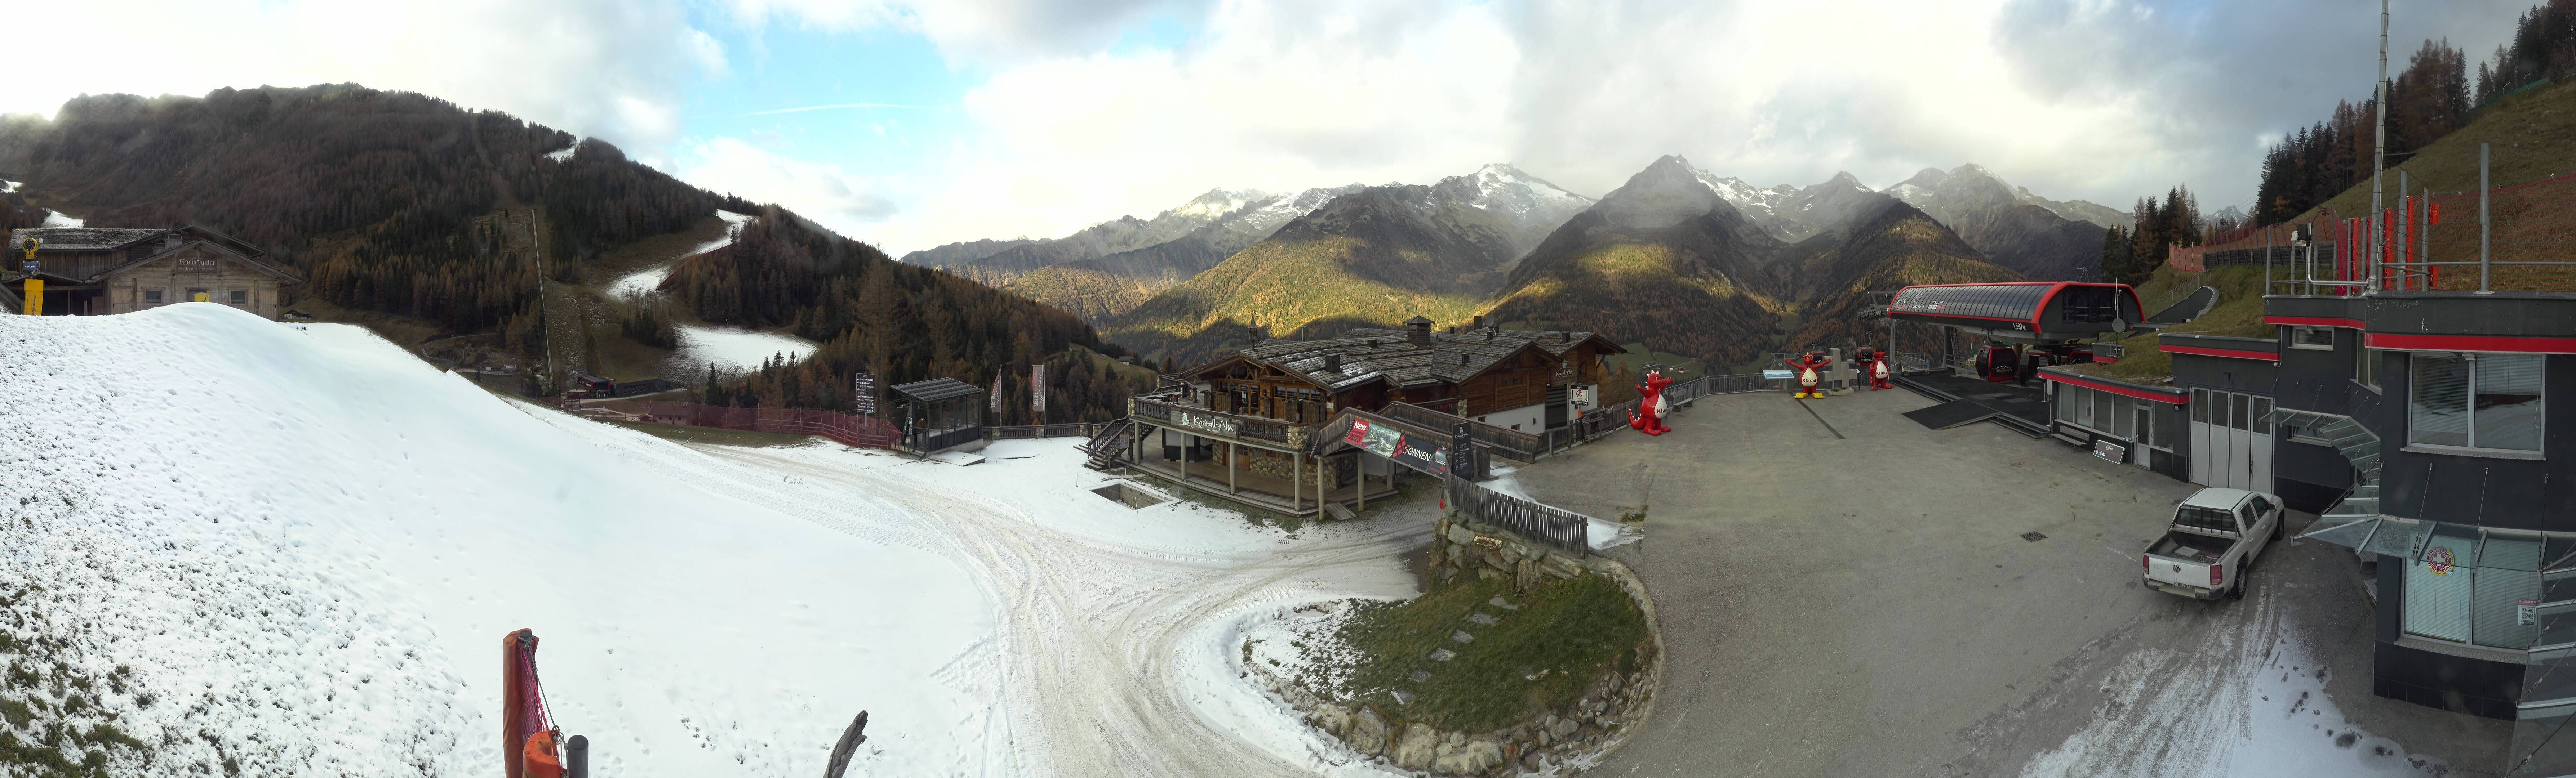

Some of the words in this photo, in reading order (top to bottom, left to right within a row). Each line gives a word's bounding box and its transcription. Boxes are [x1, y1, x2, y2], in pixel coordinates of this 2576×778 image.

[1354, 421, 1367, 431] New
[1348, 433, 1362, 443] 2023
[1403, 444, 1431, 462] SONNEN
[2429, 549, 2440, 557] WEISSES
[2441, 550, 2449, 560] KREUZ
